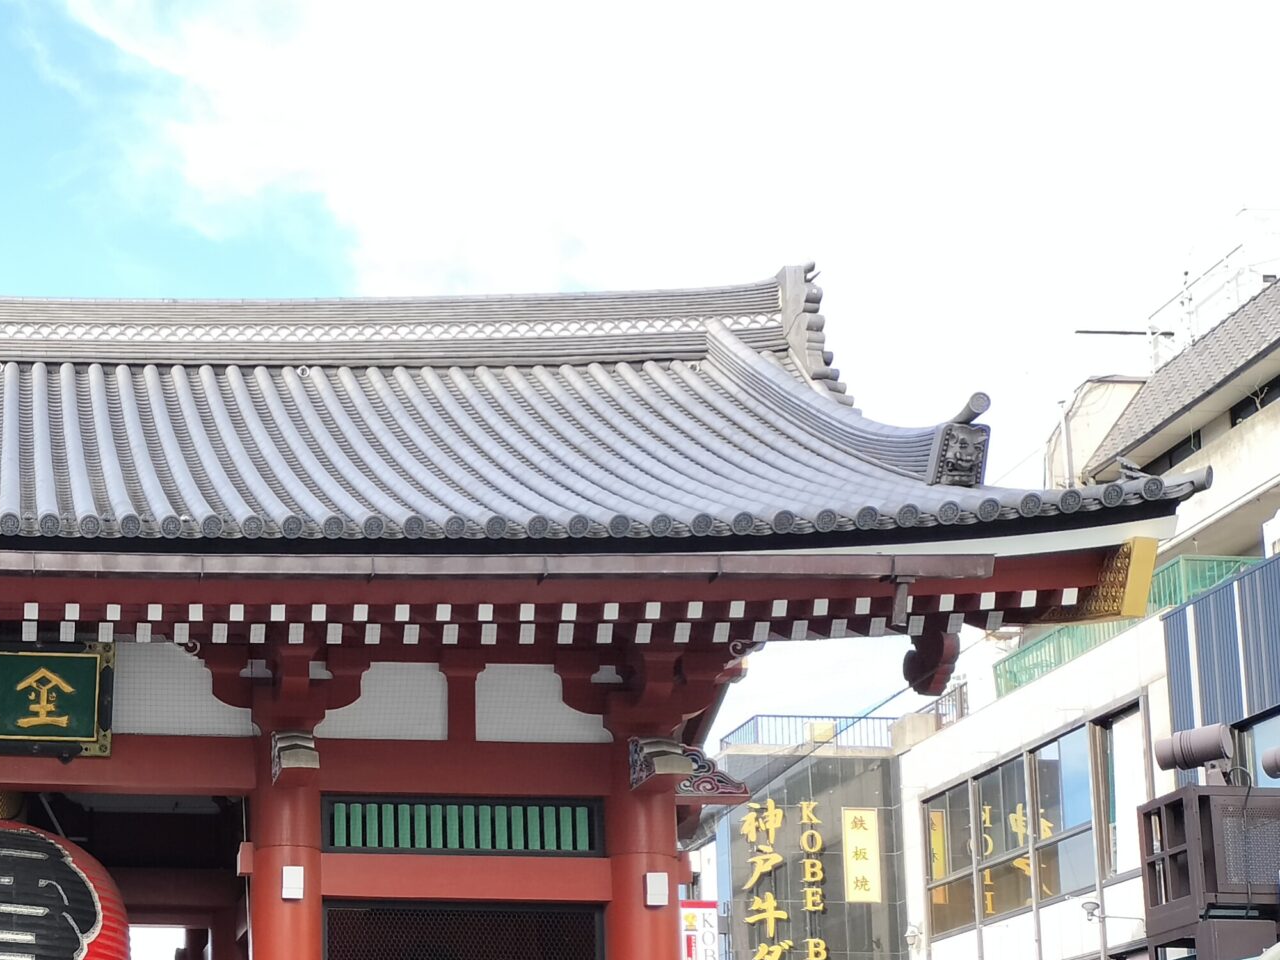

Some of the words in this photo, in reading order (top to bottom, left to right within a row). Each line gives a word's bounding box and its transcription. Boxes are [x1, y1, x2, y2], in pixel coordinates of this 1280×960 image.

[801, 801, 824, 911] KOBE
[850, 815, 870, 893] 鉄板焼
